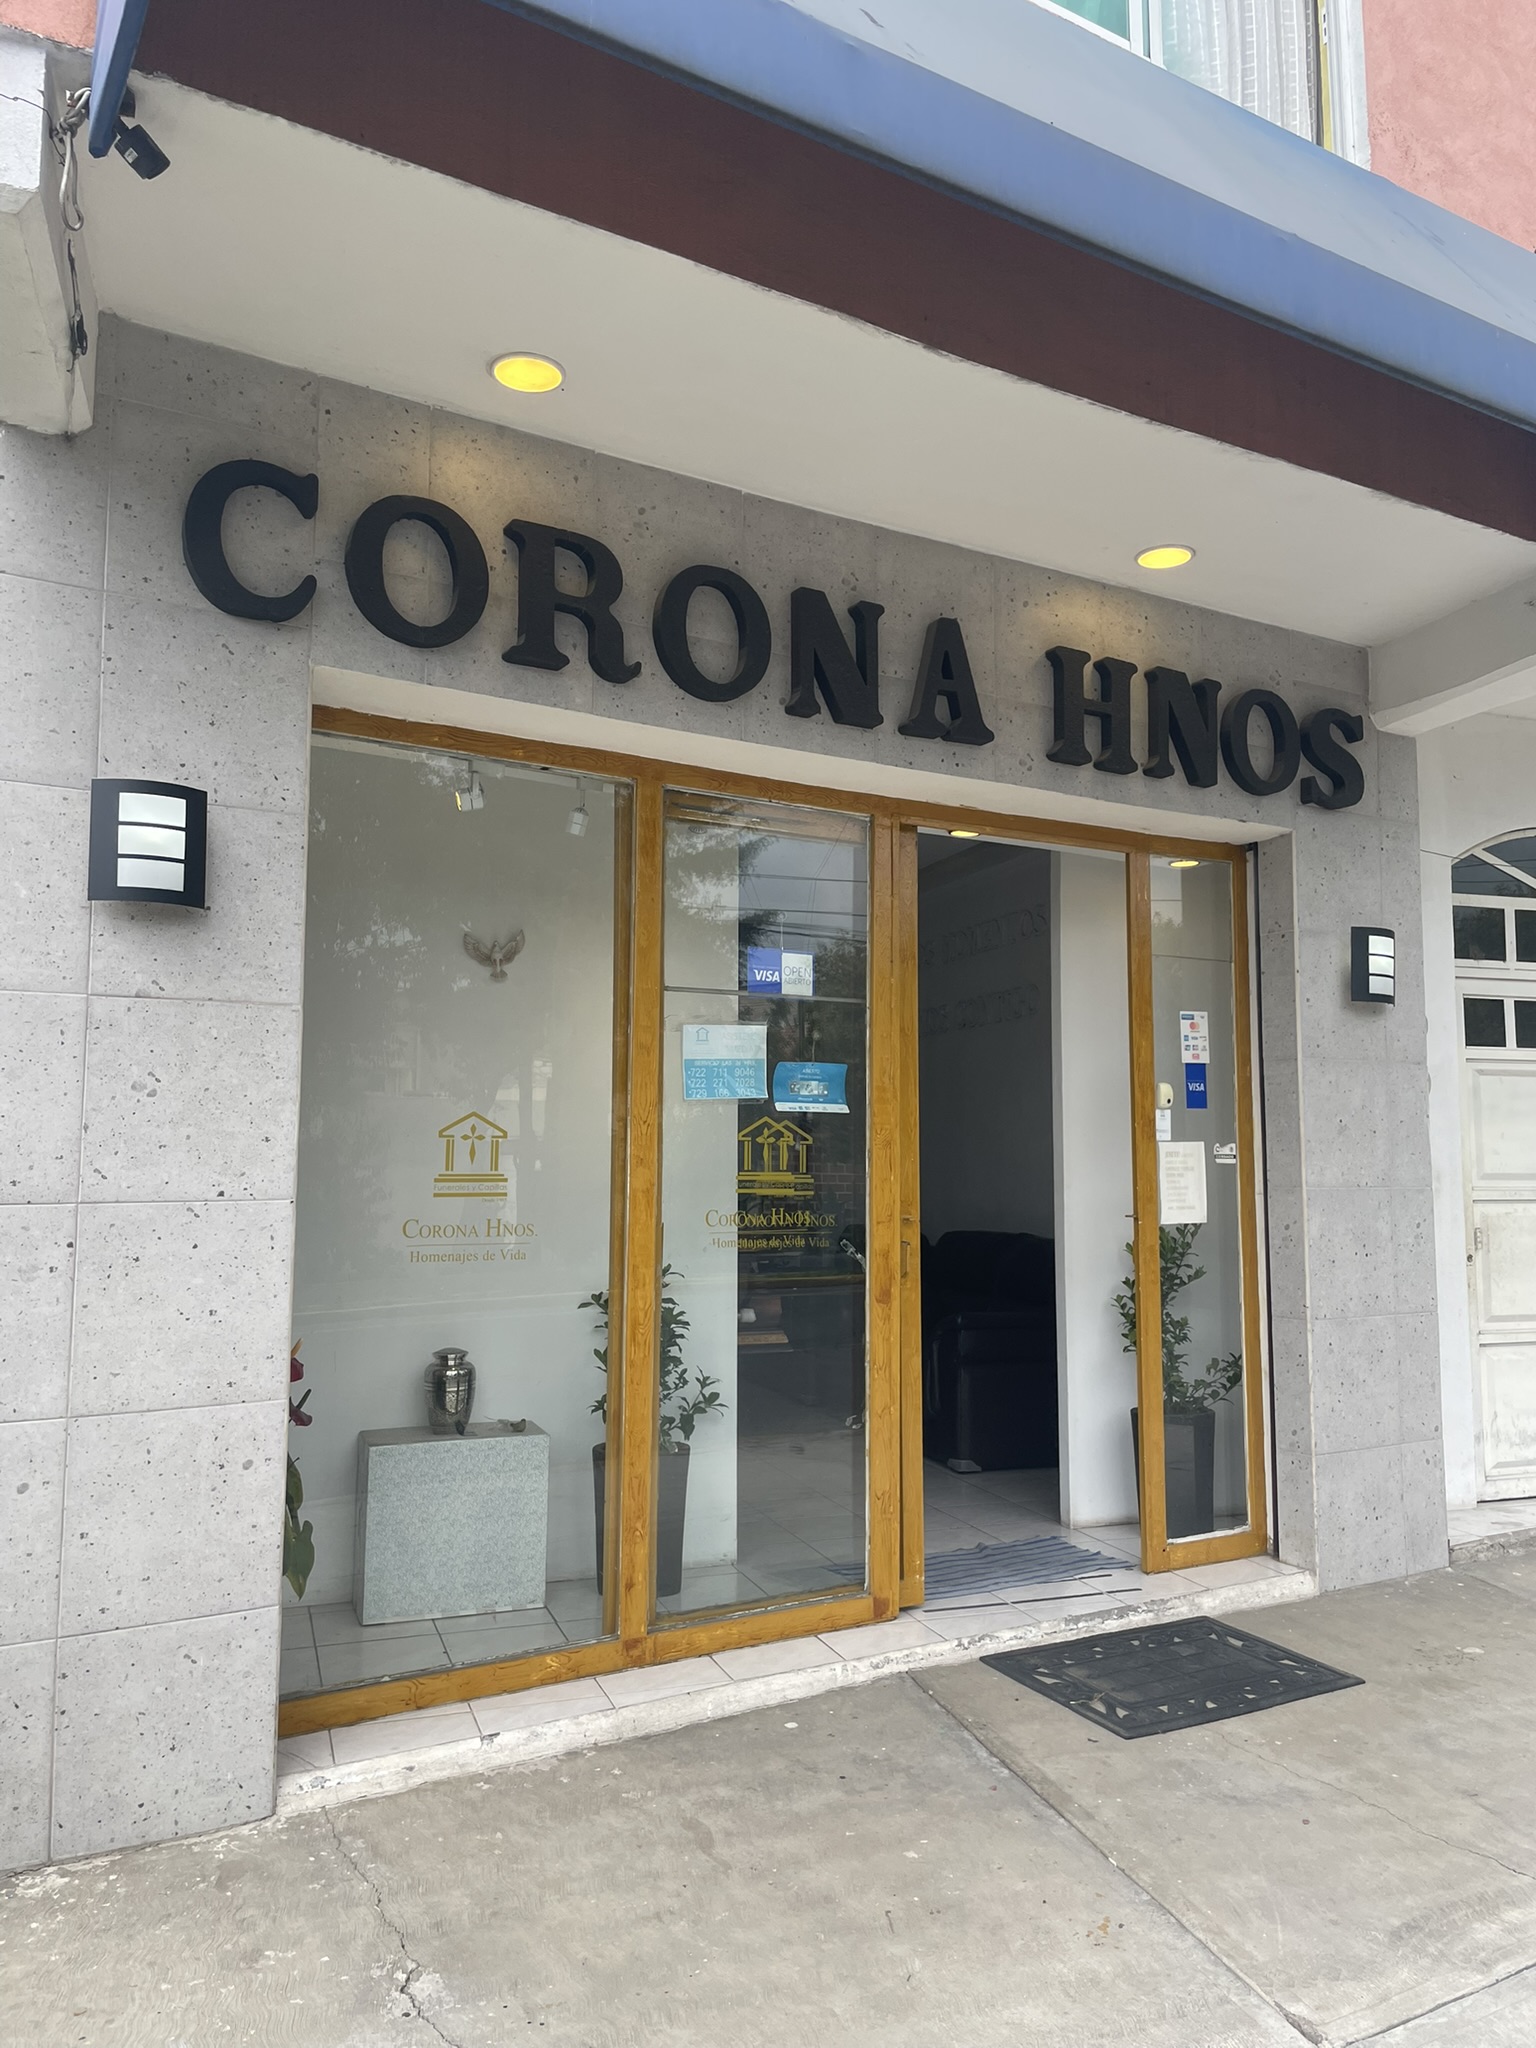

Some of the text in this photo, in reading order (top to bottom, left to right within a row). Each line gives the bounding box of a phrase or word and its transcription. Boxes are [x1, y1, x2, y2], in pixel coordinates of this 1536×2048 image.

[182, 459, 1365, 810] CORONA HNOS
[753, 969, 780, 982] VISA
[783, 965, 812, 978] OPEN
[690, 1067, 756, 1077] 722 711 9046
[690, 1078, 756, 1088] 722 271 7028
[1187, 1082, 1205, 1091] VISA
[410, 1248, 527, 1264] Homenajes de Vida
